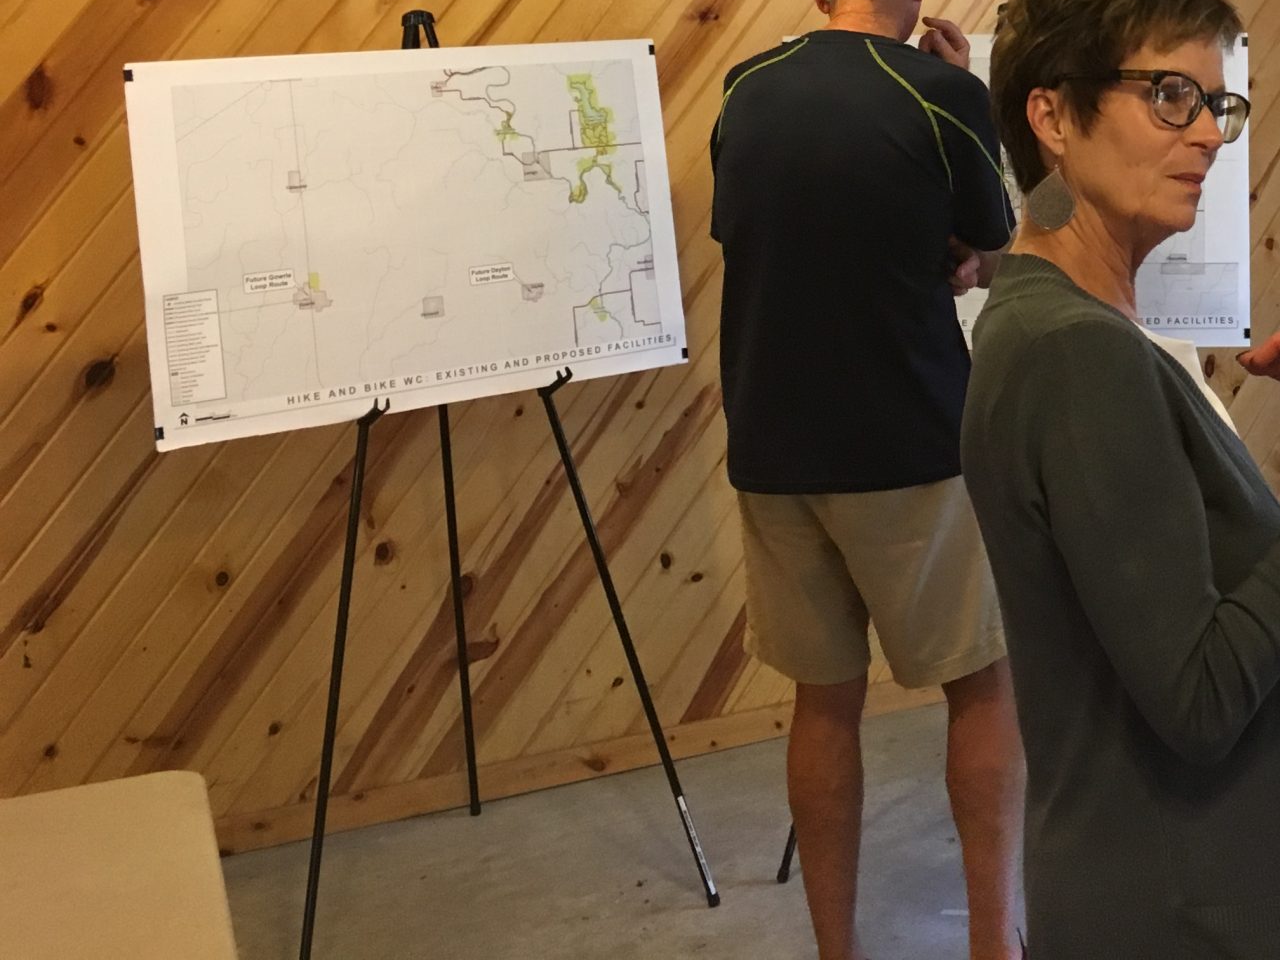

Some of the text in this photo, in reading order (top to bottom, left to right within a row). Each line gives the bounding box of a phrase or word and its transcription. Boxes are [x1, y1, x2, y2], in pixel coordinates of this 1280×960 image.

[1167, 316, 1234, 325] FACILITIES
[287, 392, 321, 405] HIKE
[328, 386, 357, 398] AND
[364, 380, 397, 393] BIKE
[436, 362, 498, 381] EXISTING
[504, 358, 529, 369] AND
[536, 346, 601, 364] PROPOSED
[607, 334, 672, 352] FACILITIES
